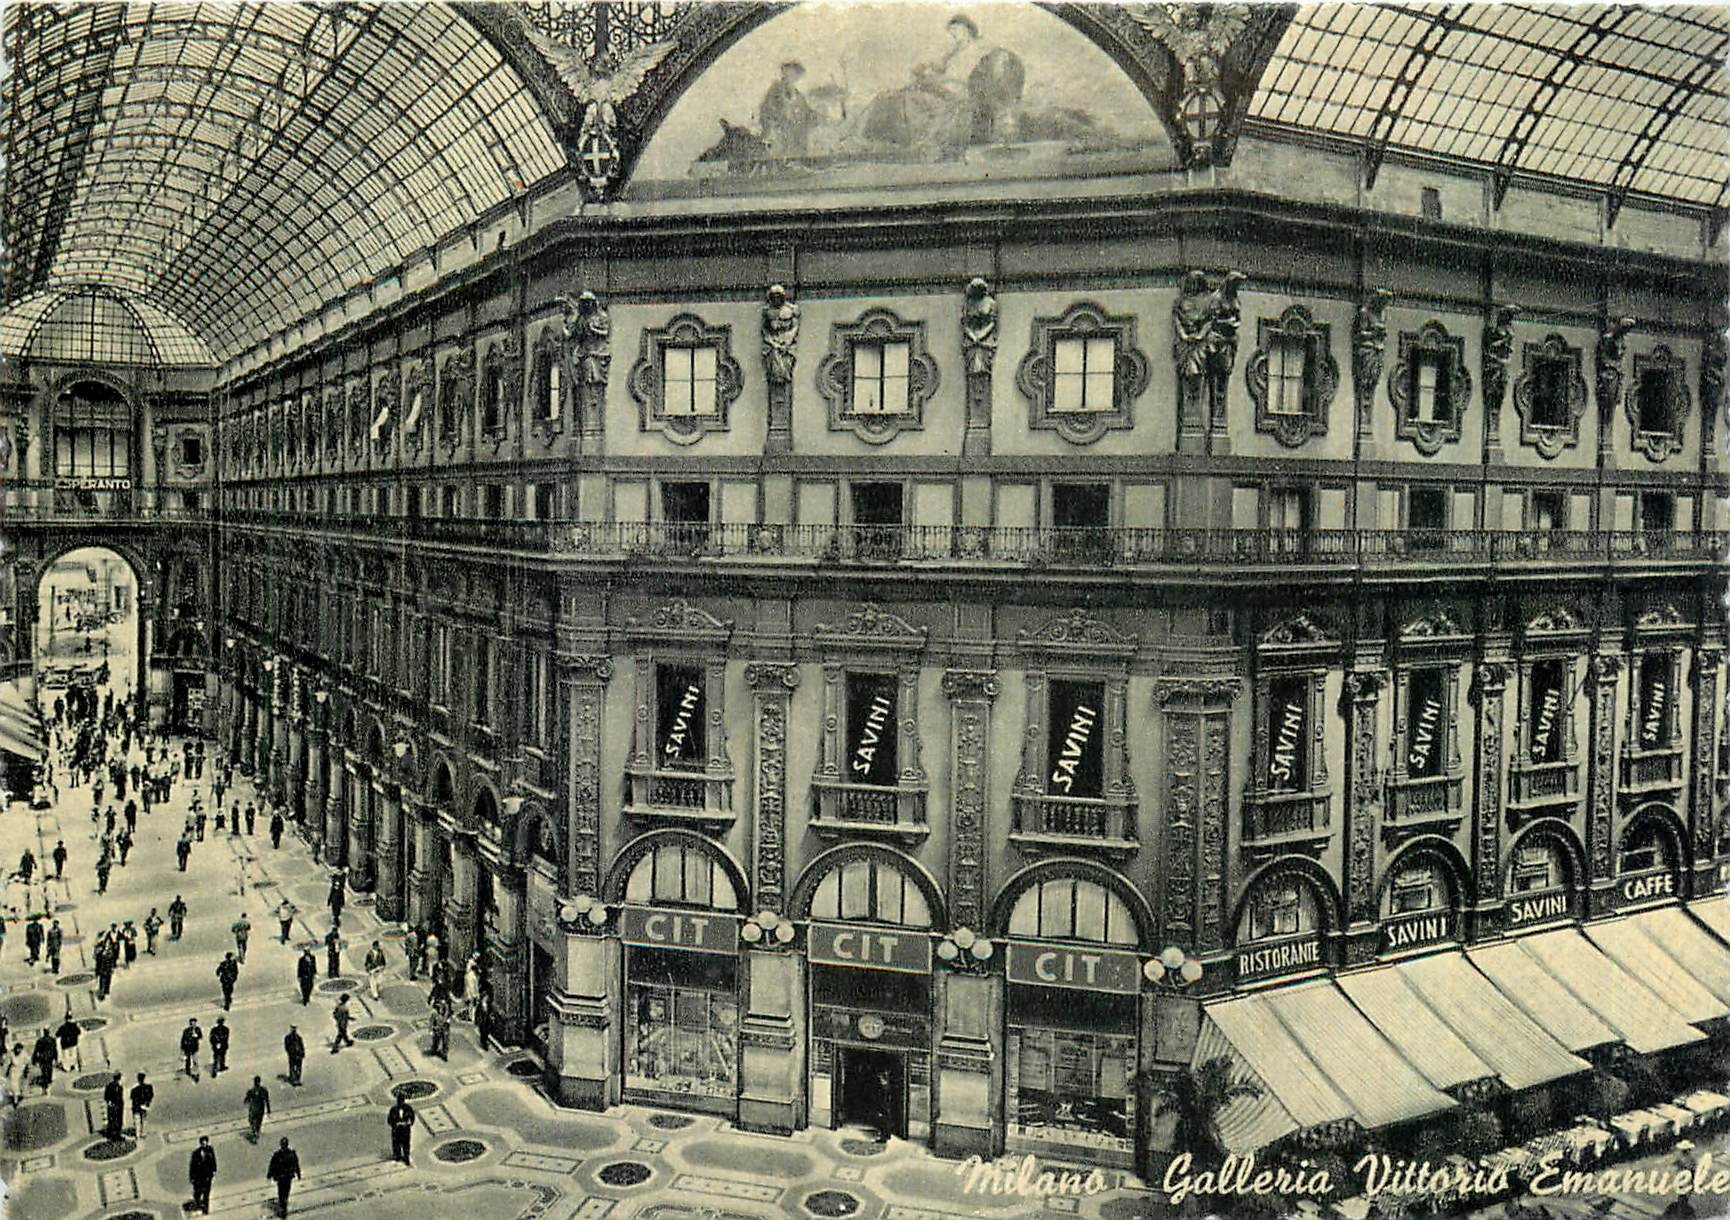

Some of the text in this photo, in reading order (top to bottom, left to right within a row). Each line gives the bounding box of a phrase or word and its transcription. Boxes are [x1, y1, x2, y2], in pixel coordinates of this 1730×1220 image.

[665, 685, 700, 757] SAVINI
[853, 696, 891, 775] SAVINI
[1271, 703, 1303, 781] SAVINI
[1409, 699, 1442, 769] SAVINI
[1532, 688, 1561, 757] SAVINI
[1642, 681, 1667, 742] SAVINI
[1052, 705, 1097, 793] SAVINI
[645, 913, 709, 946] CIT
[833, 932, 899, 964] CIT
[1239, 941, 1321, 976] RISTORANTE
[1386, 917, 1448, 947] SAVINI
[1511, 895, 1567, 923] SAVINI
[1035, 951, 1102, 984] CIT
